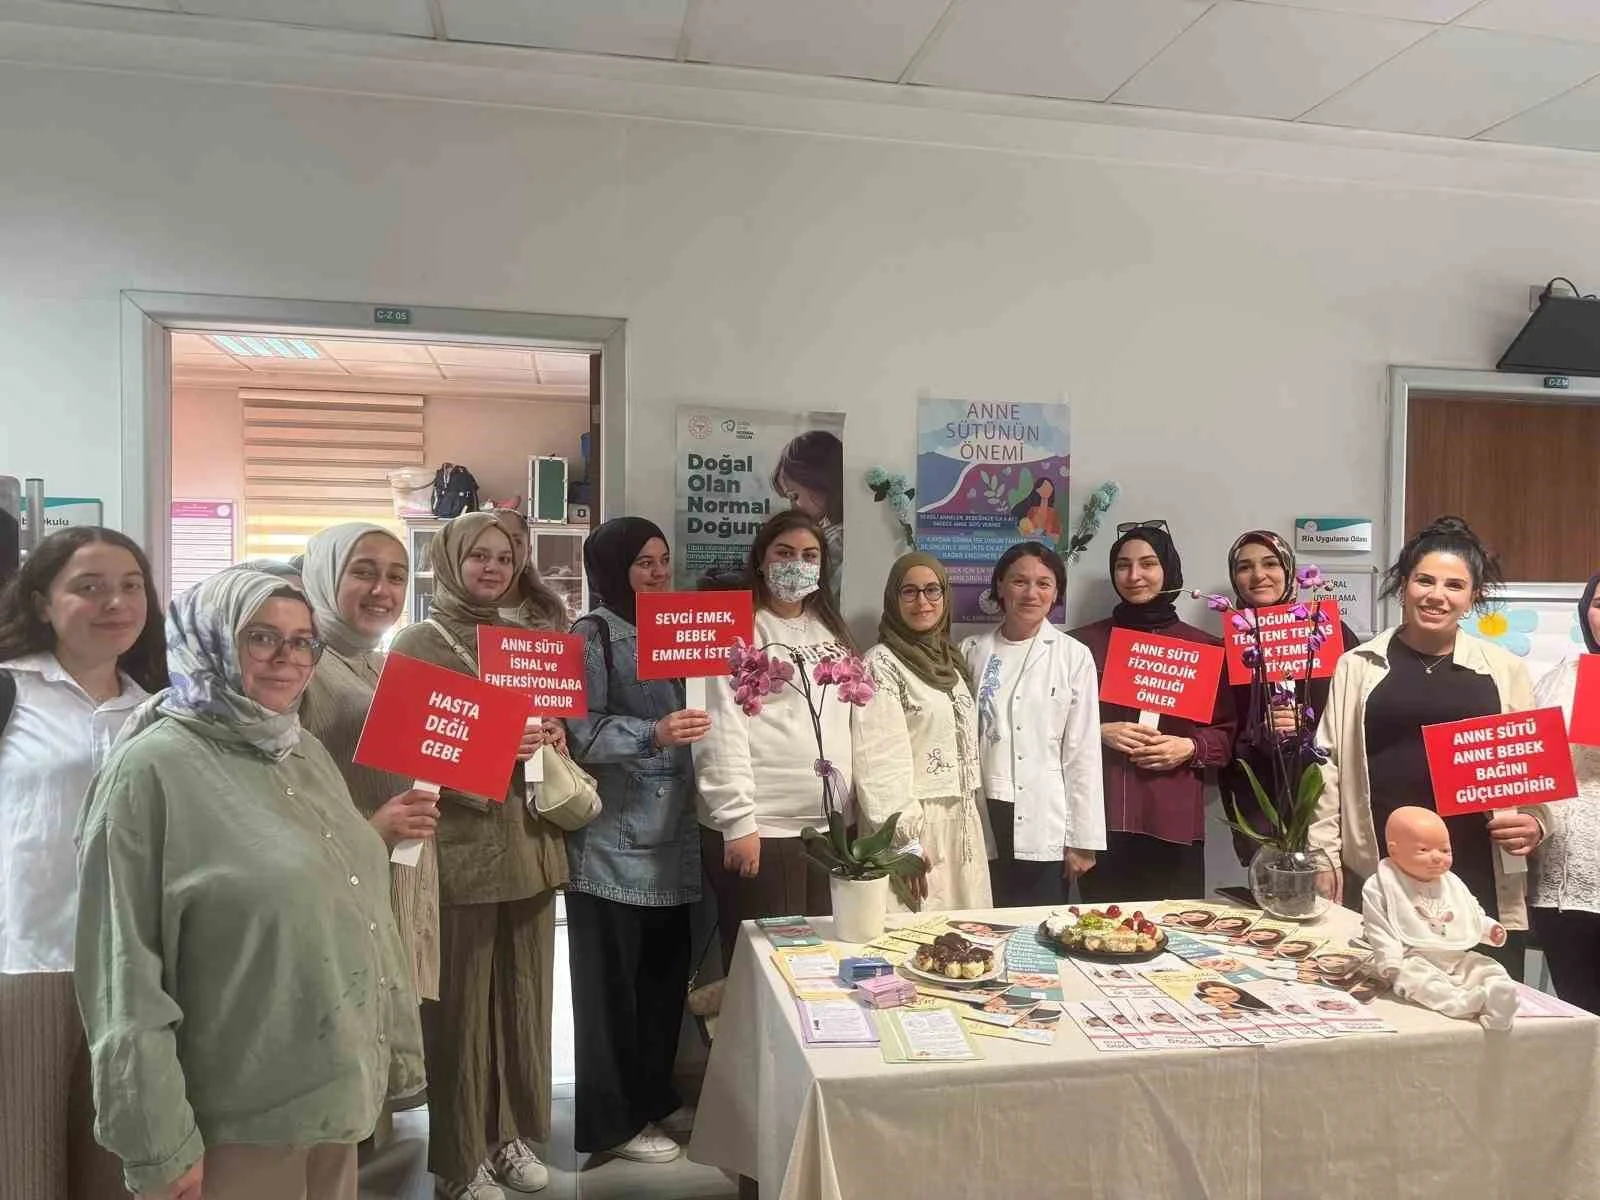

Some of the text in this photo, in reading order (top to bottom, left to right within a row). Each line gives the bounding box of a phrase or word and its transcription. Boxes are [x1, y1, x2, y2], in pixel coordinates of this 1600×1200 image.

[967, 403, 1020, 420] ANNE
[946, 422, 1039, 441] SÜTÜNÜN
[960, 441, 1024, 461] ÖNEMİ
[687, 453, 753, 475] Doğal
[687, 474, 741, 494] Olan
[687, 496, 770, 515] Normal
[1316, 535, 1349, 543] Uygulama
[655, 609, 735, 625] SEVGİ EMEK,
[1253, 612, 1296, 627] OĞUM
[676, 629, 717, 643] BEBEK
[1259, 629, 1288, 643] TENE
[501, 637, 564, 655] ANNE SÜTÜ
[652, 645, 731, 662] EMMEK İSTE
[1131, 642, 1200, 664] ANNE SÜTÜ
[1276, 643, 1308, 656] TEME
[510, 654, 558, 672] İSHAL ve
[1128, 656, 1198, 680] FİZYOLOJİK
[484, 673, 583, 690] ENFEKSİYONLARA
[1133, 674, 1185, 693] SARILIĞI
[428, 690, 480, 720] HASTA
[534, 694, 573, 708] KORUR
[1136, 688, 1176, 707] ÖNLER
[425, 714, 470, 741] DEĞİL
[1453, 718, 1537, 746] ANNE SÜTÜ
[421, 739, 463, 763] GEBE
[1453, 740, 1544, 765] ANNE BEBEK
[1475, 761, 1528, 781] BAĞINI
[1455, 775, 1556, 804] GÜÇLENDİRİR
